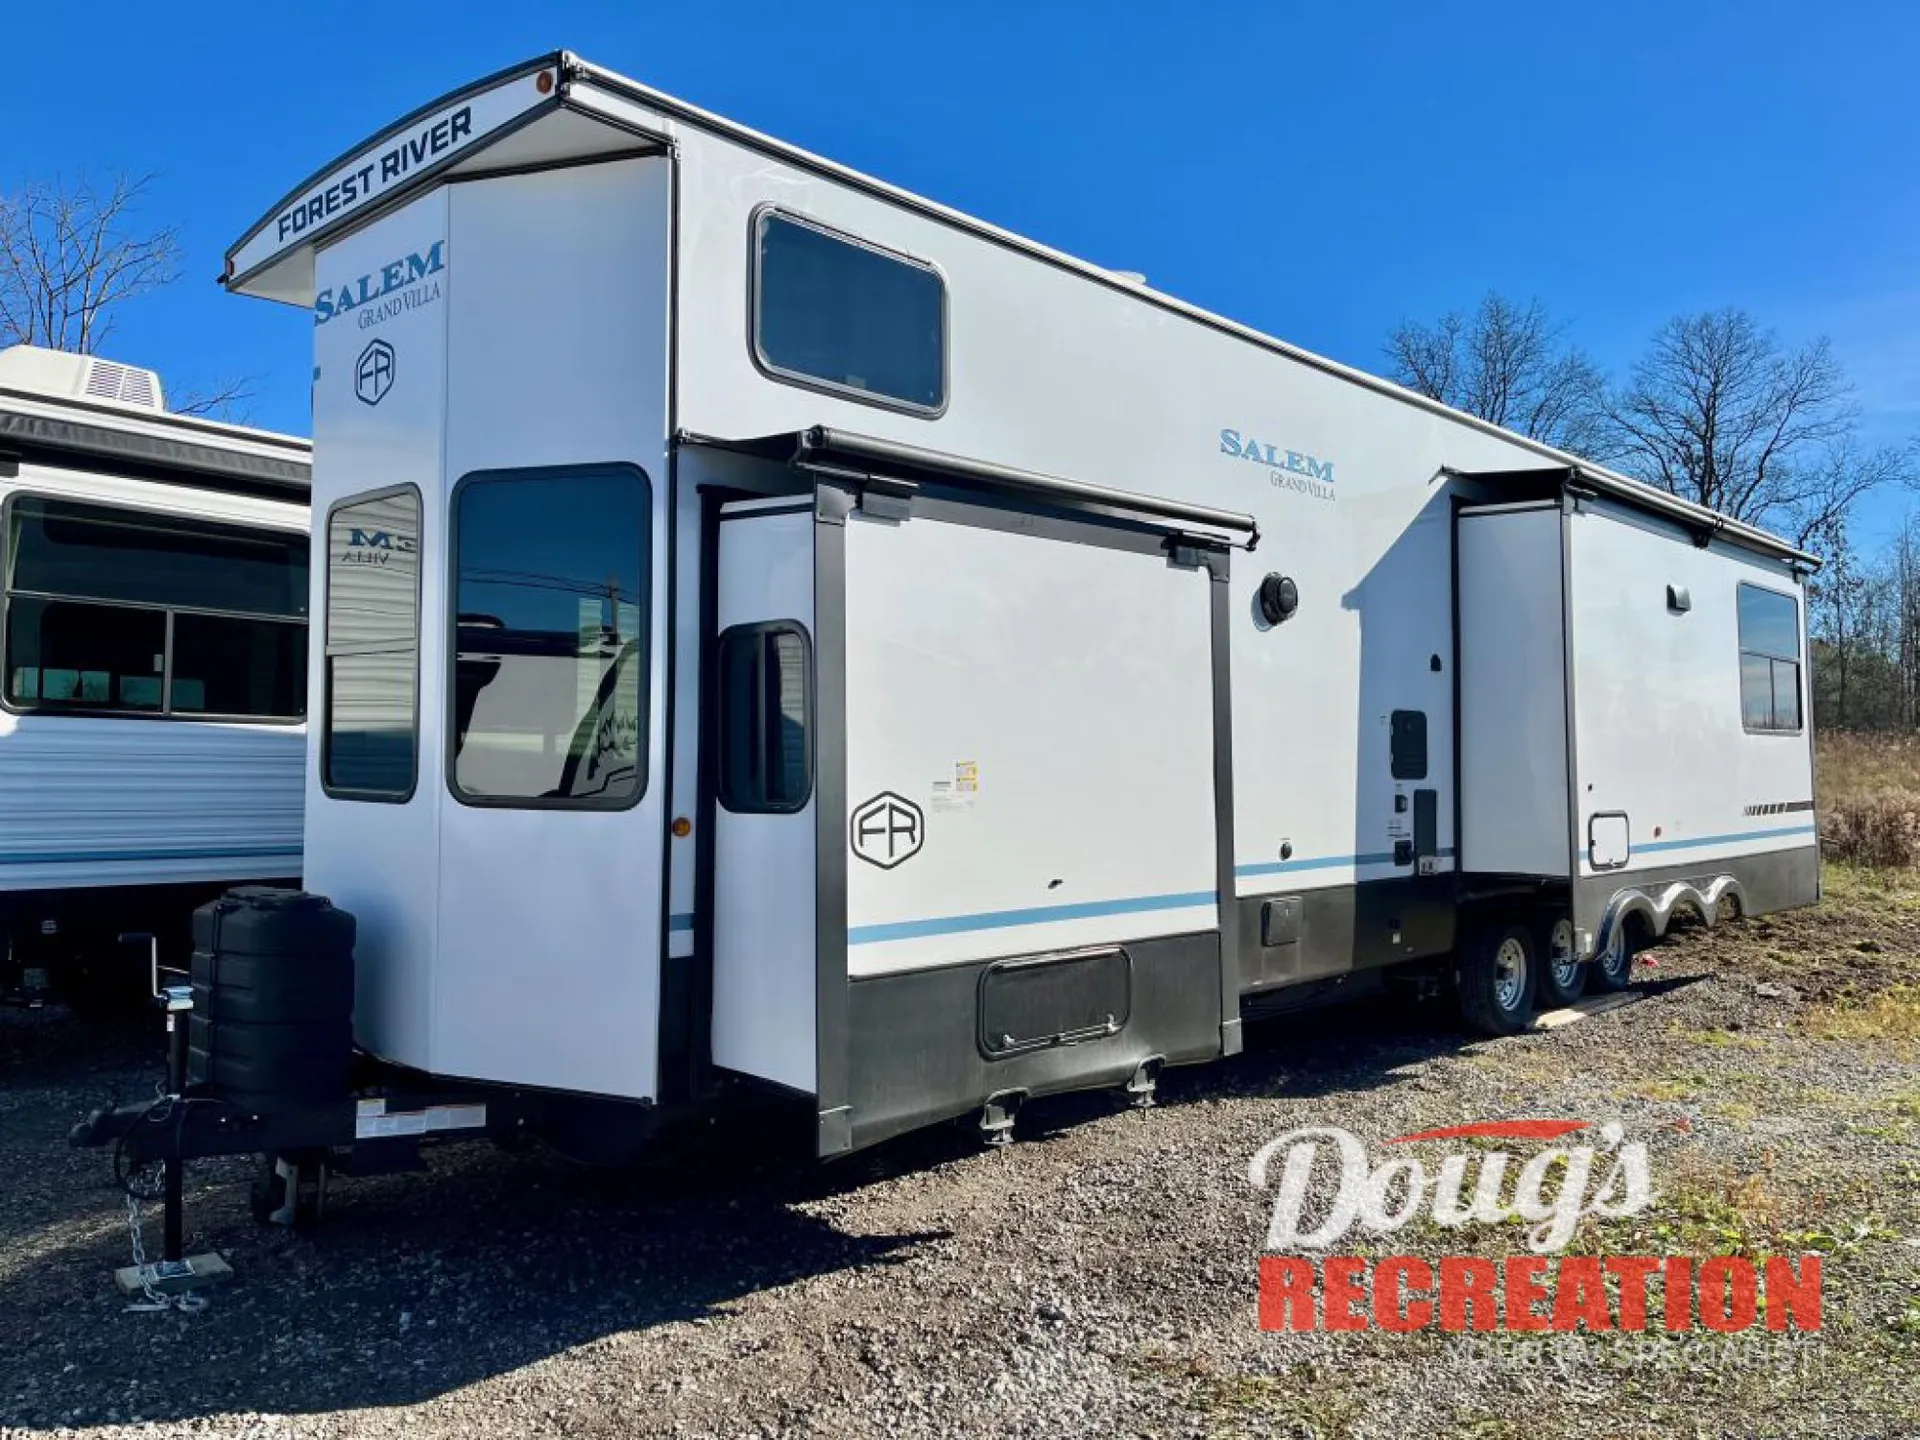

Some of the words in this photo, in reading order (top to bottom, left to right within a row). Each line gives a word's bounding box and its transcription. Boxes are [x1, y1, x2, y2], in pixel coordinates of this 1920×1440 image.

[277, 164, 375, 242] FOREST
[380, 106, 471, 183] RIVER
[315, 240, 445, 327] SALEM
[358, 298, 402, 330] GRAND
[403, 281, 440, 312] VILLA
[1220, 429, 1335, 482] SALEM
[1270, 470, 1307, 494] GRAND
[1308, 480, 1336, 502] VILLA
